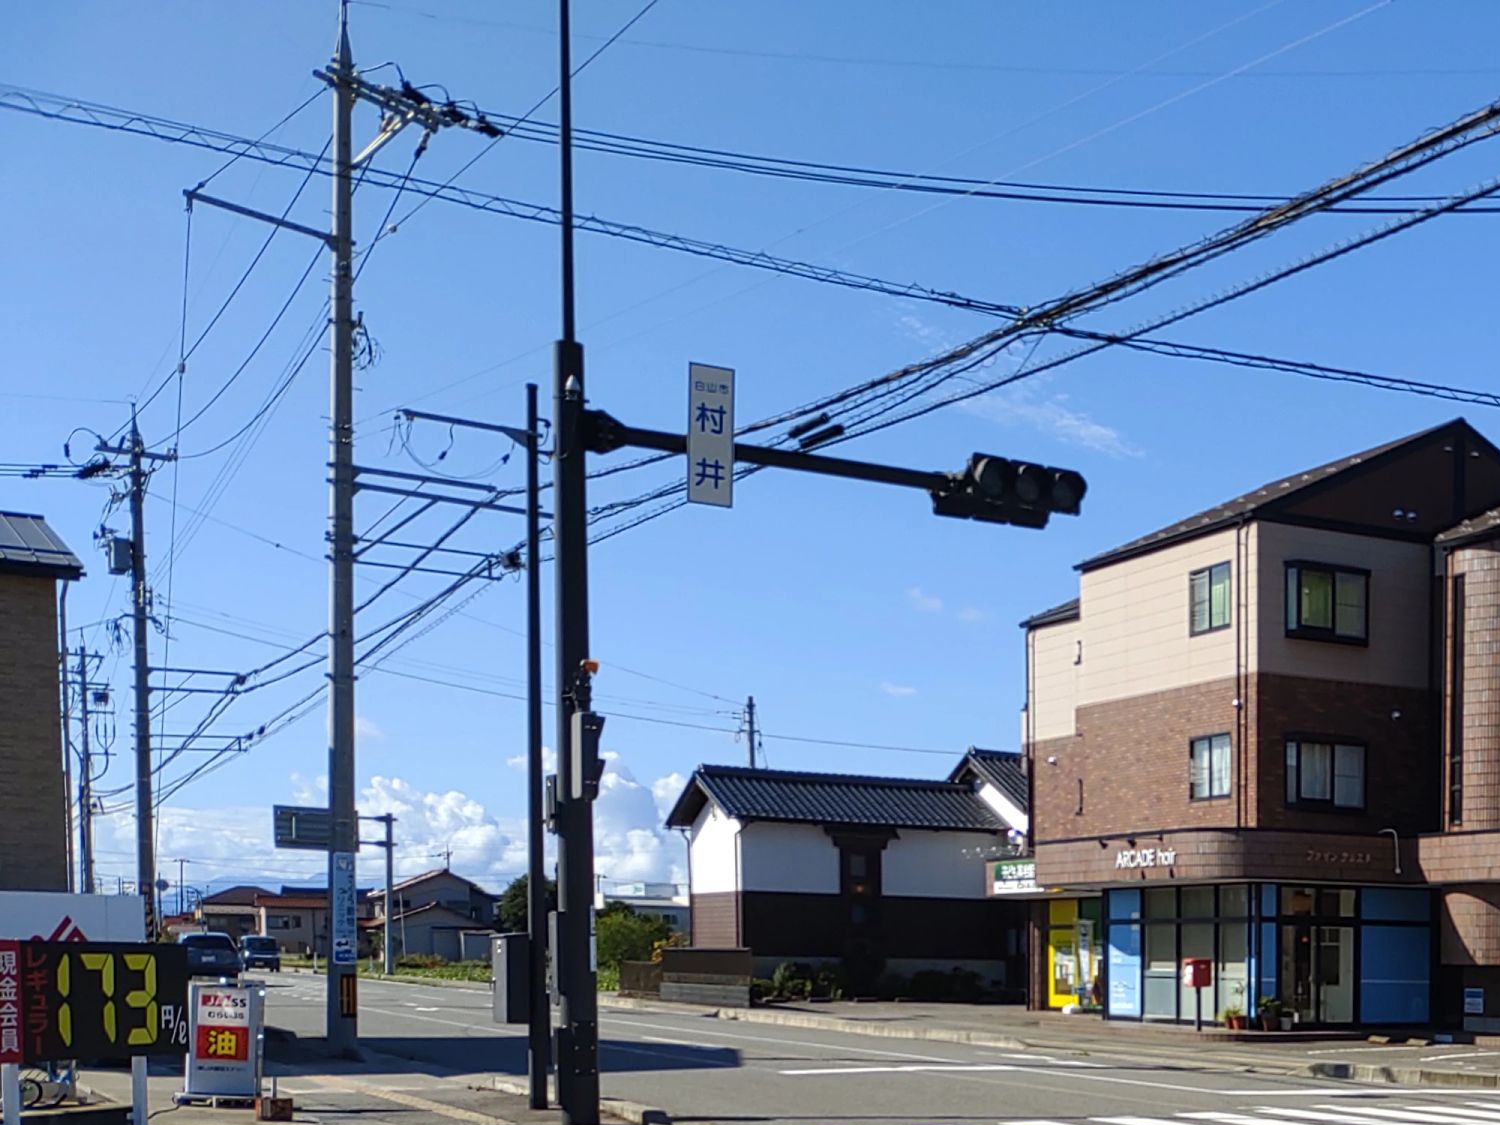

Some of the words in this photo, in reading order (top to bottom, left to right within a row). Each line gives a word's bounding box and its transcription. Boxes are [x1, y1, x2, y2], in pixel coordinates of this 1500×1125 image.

[695, 381, 729, 394] 白山市
[695, 402, 727, 489] 村井
[1115, 850, 1155, 868] ARCADE
[1157, 848, 1176, 865] hair
[0, 951, 19, 1053] 現金会員
[26, 947, 48, 1055] レギュラー
[57, 953, 158, 1047] 173
